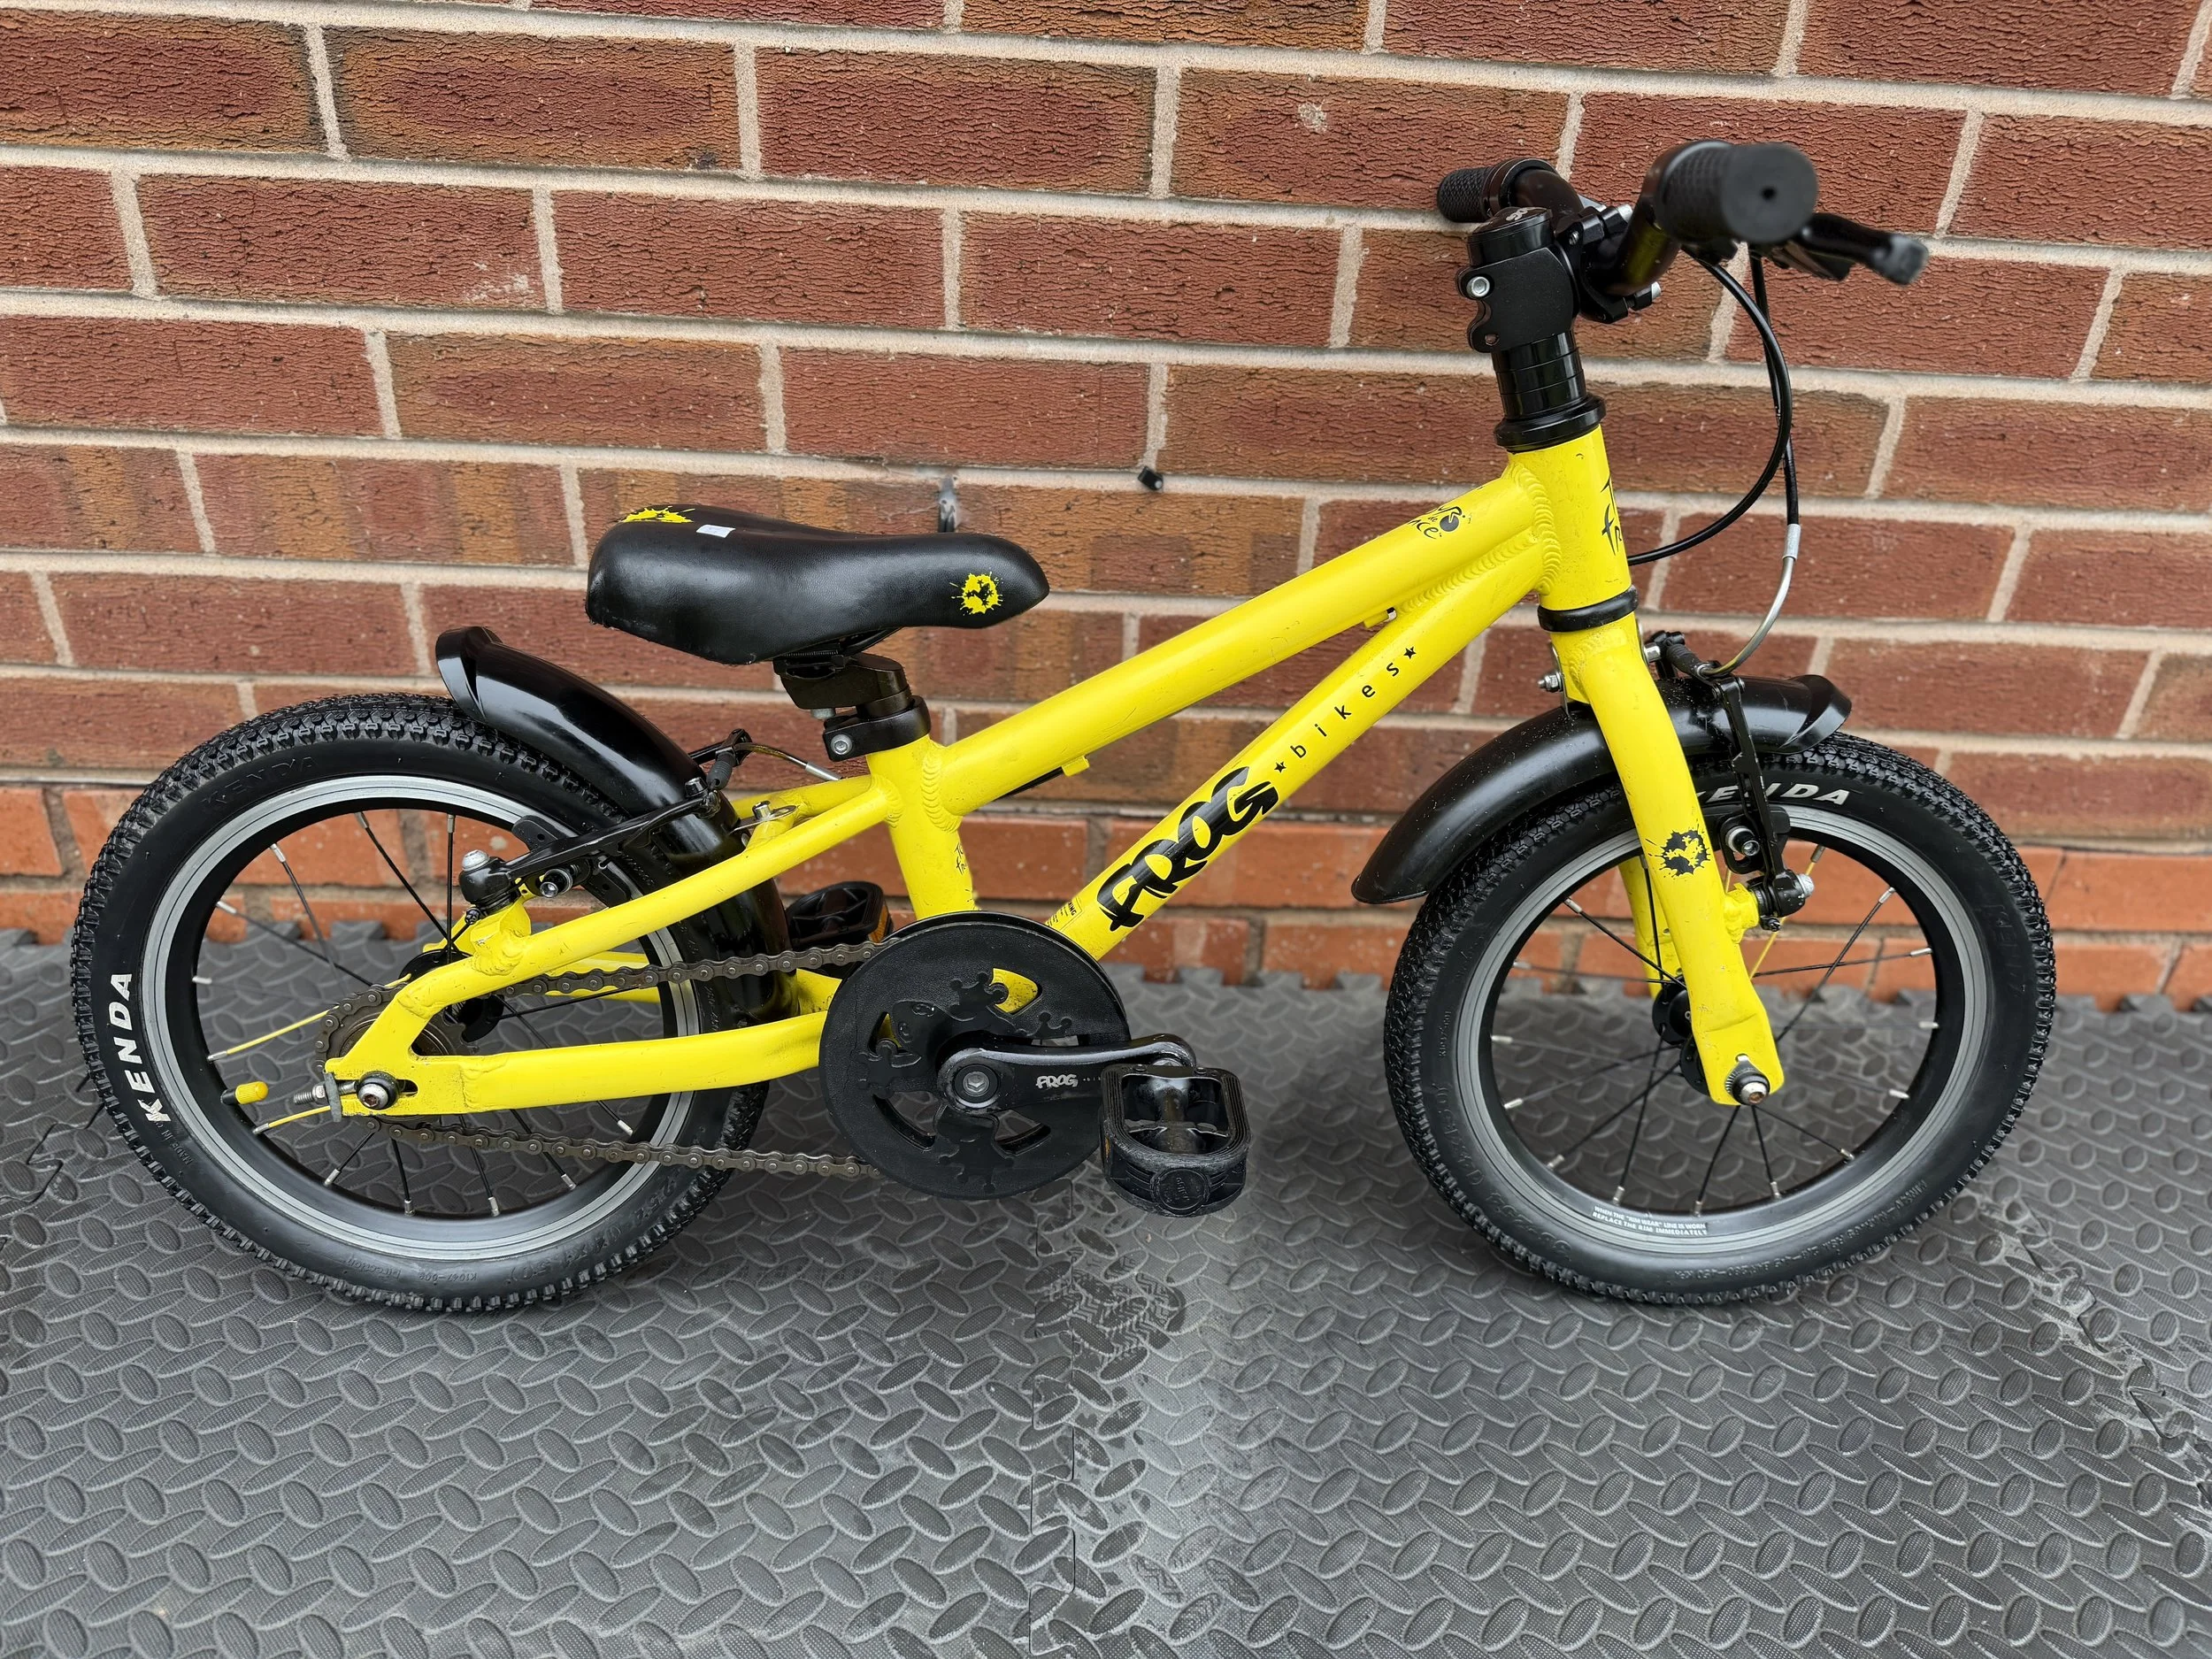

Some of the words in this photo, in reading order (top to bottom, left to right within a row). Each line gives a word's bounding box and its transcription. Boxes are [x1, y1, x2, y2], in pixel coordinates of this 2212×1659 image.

[1096, 766, 1279, 932] FROG
[1290, 662, 1401, 759] bikes
[108, 973, 172, 1122] KENDA
[1035, 1073, 1079, 1090] FROG
[1592, 1211, 1623, 1226] REPLACE
[1623, 1220, 1637, 1230] THE
[1638, 1224, 1654, 1233] RIM
[1655, 1226, 1708, 1236] IMMEDIATELY
[1594, 1206, 1613, 1217] WHEN
[1613, 1211, 1624, 1221] THE
